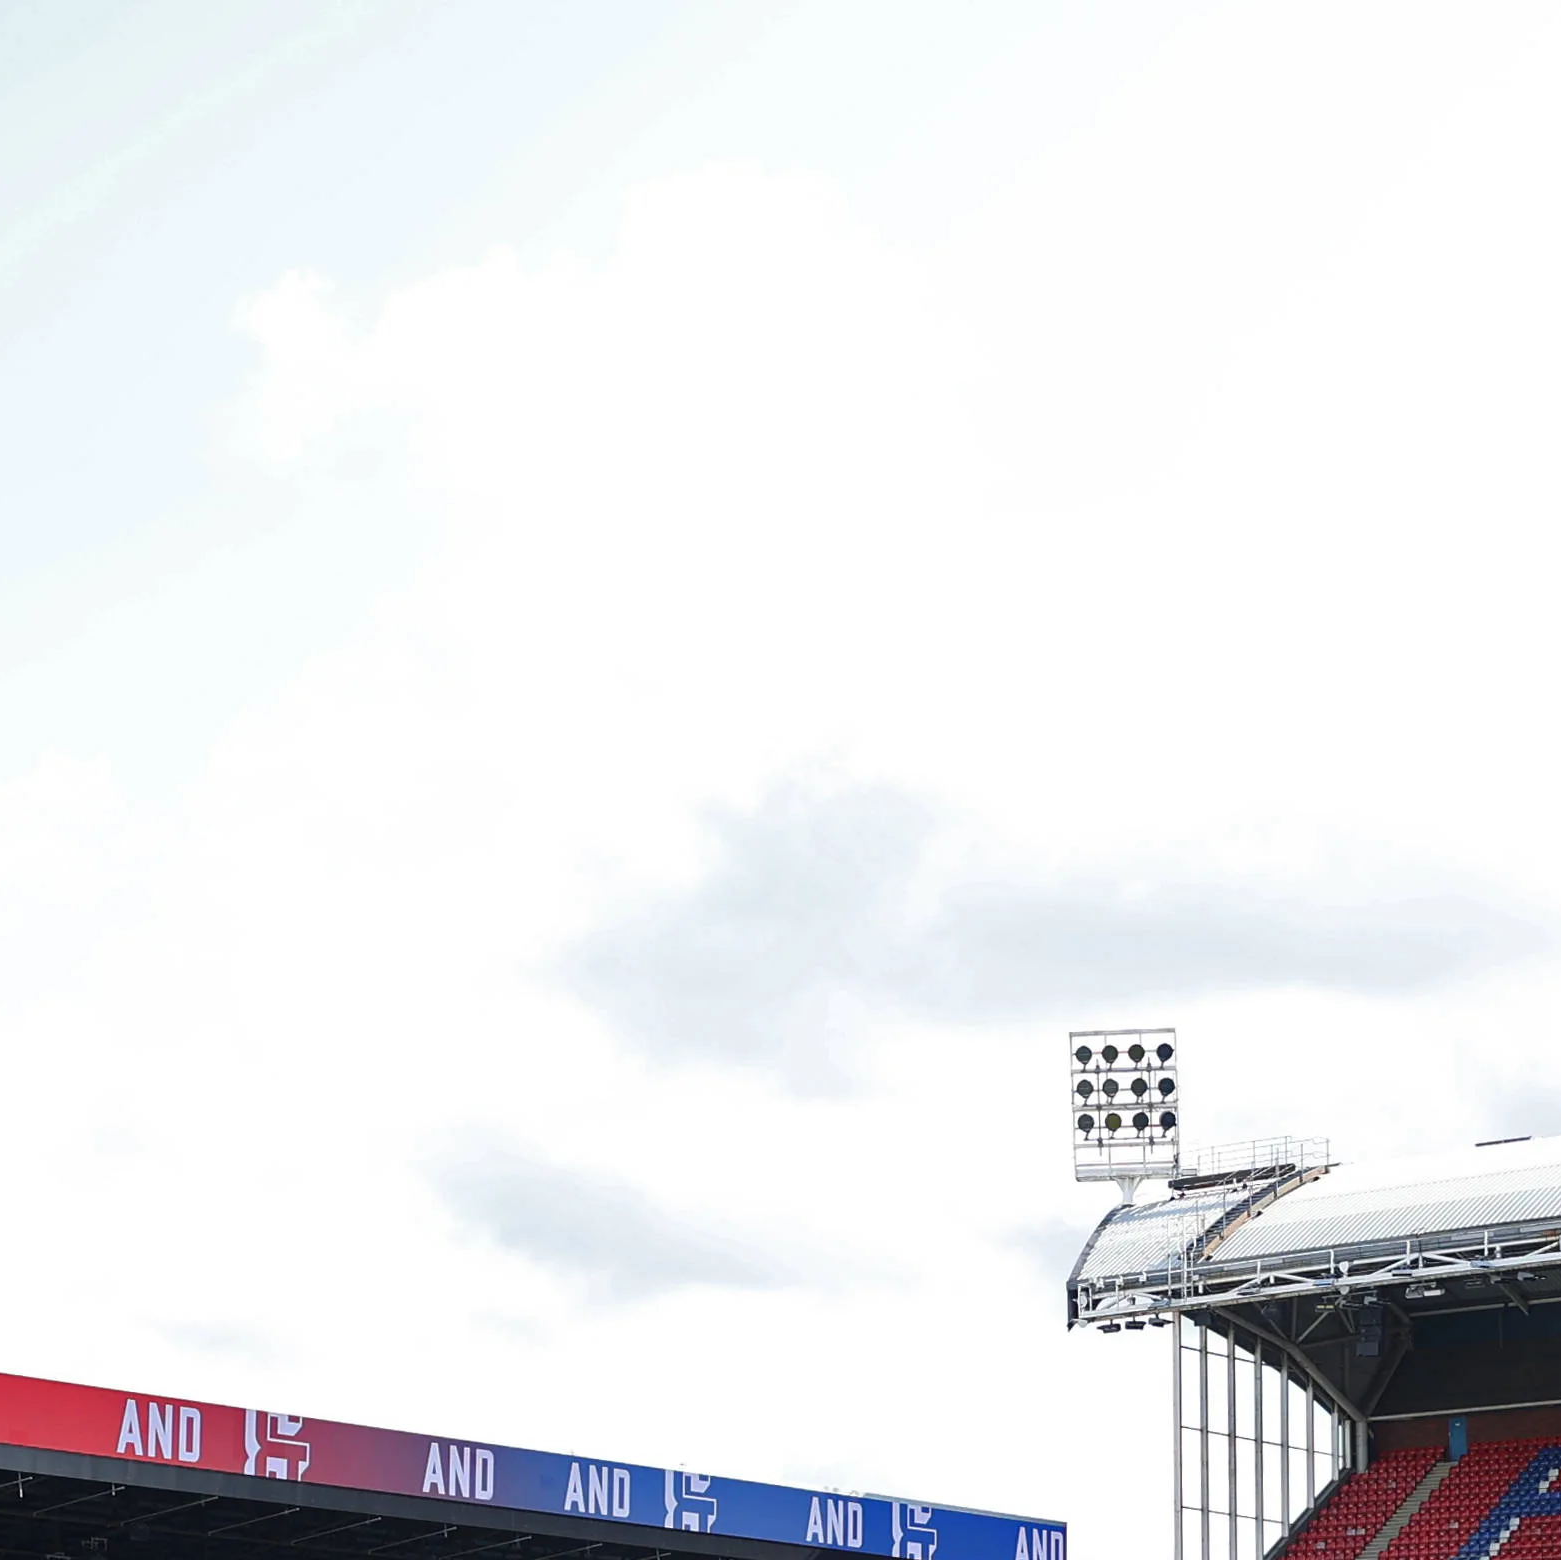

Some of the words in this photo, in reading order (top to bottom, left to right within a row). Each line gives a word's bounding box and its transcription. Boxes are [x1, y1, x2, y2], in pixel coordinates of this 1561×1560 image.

[116, 1398, 202, 1463] AND
[422, 1442, 495, 1501] AND
[564, 1461, 632, 1518] AND
[805, 1496, 864, 1548] AND
